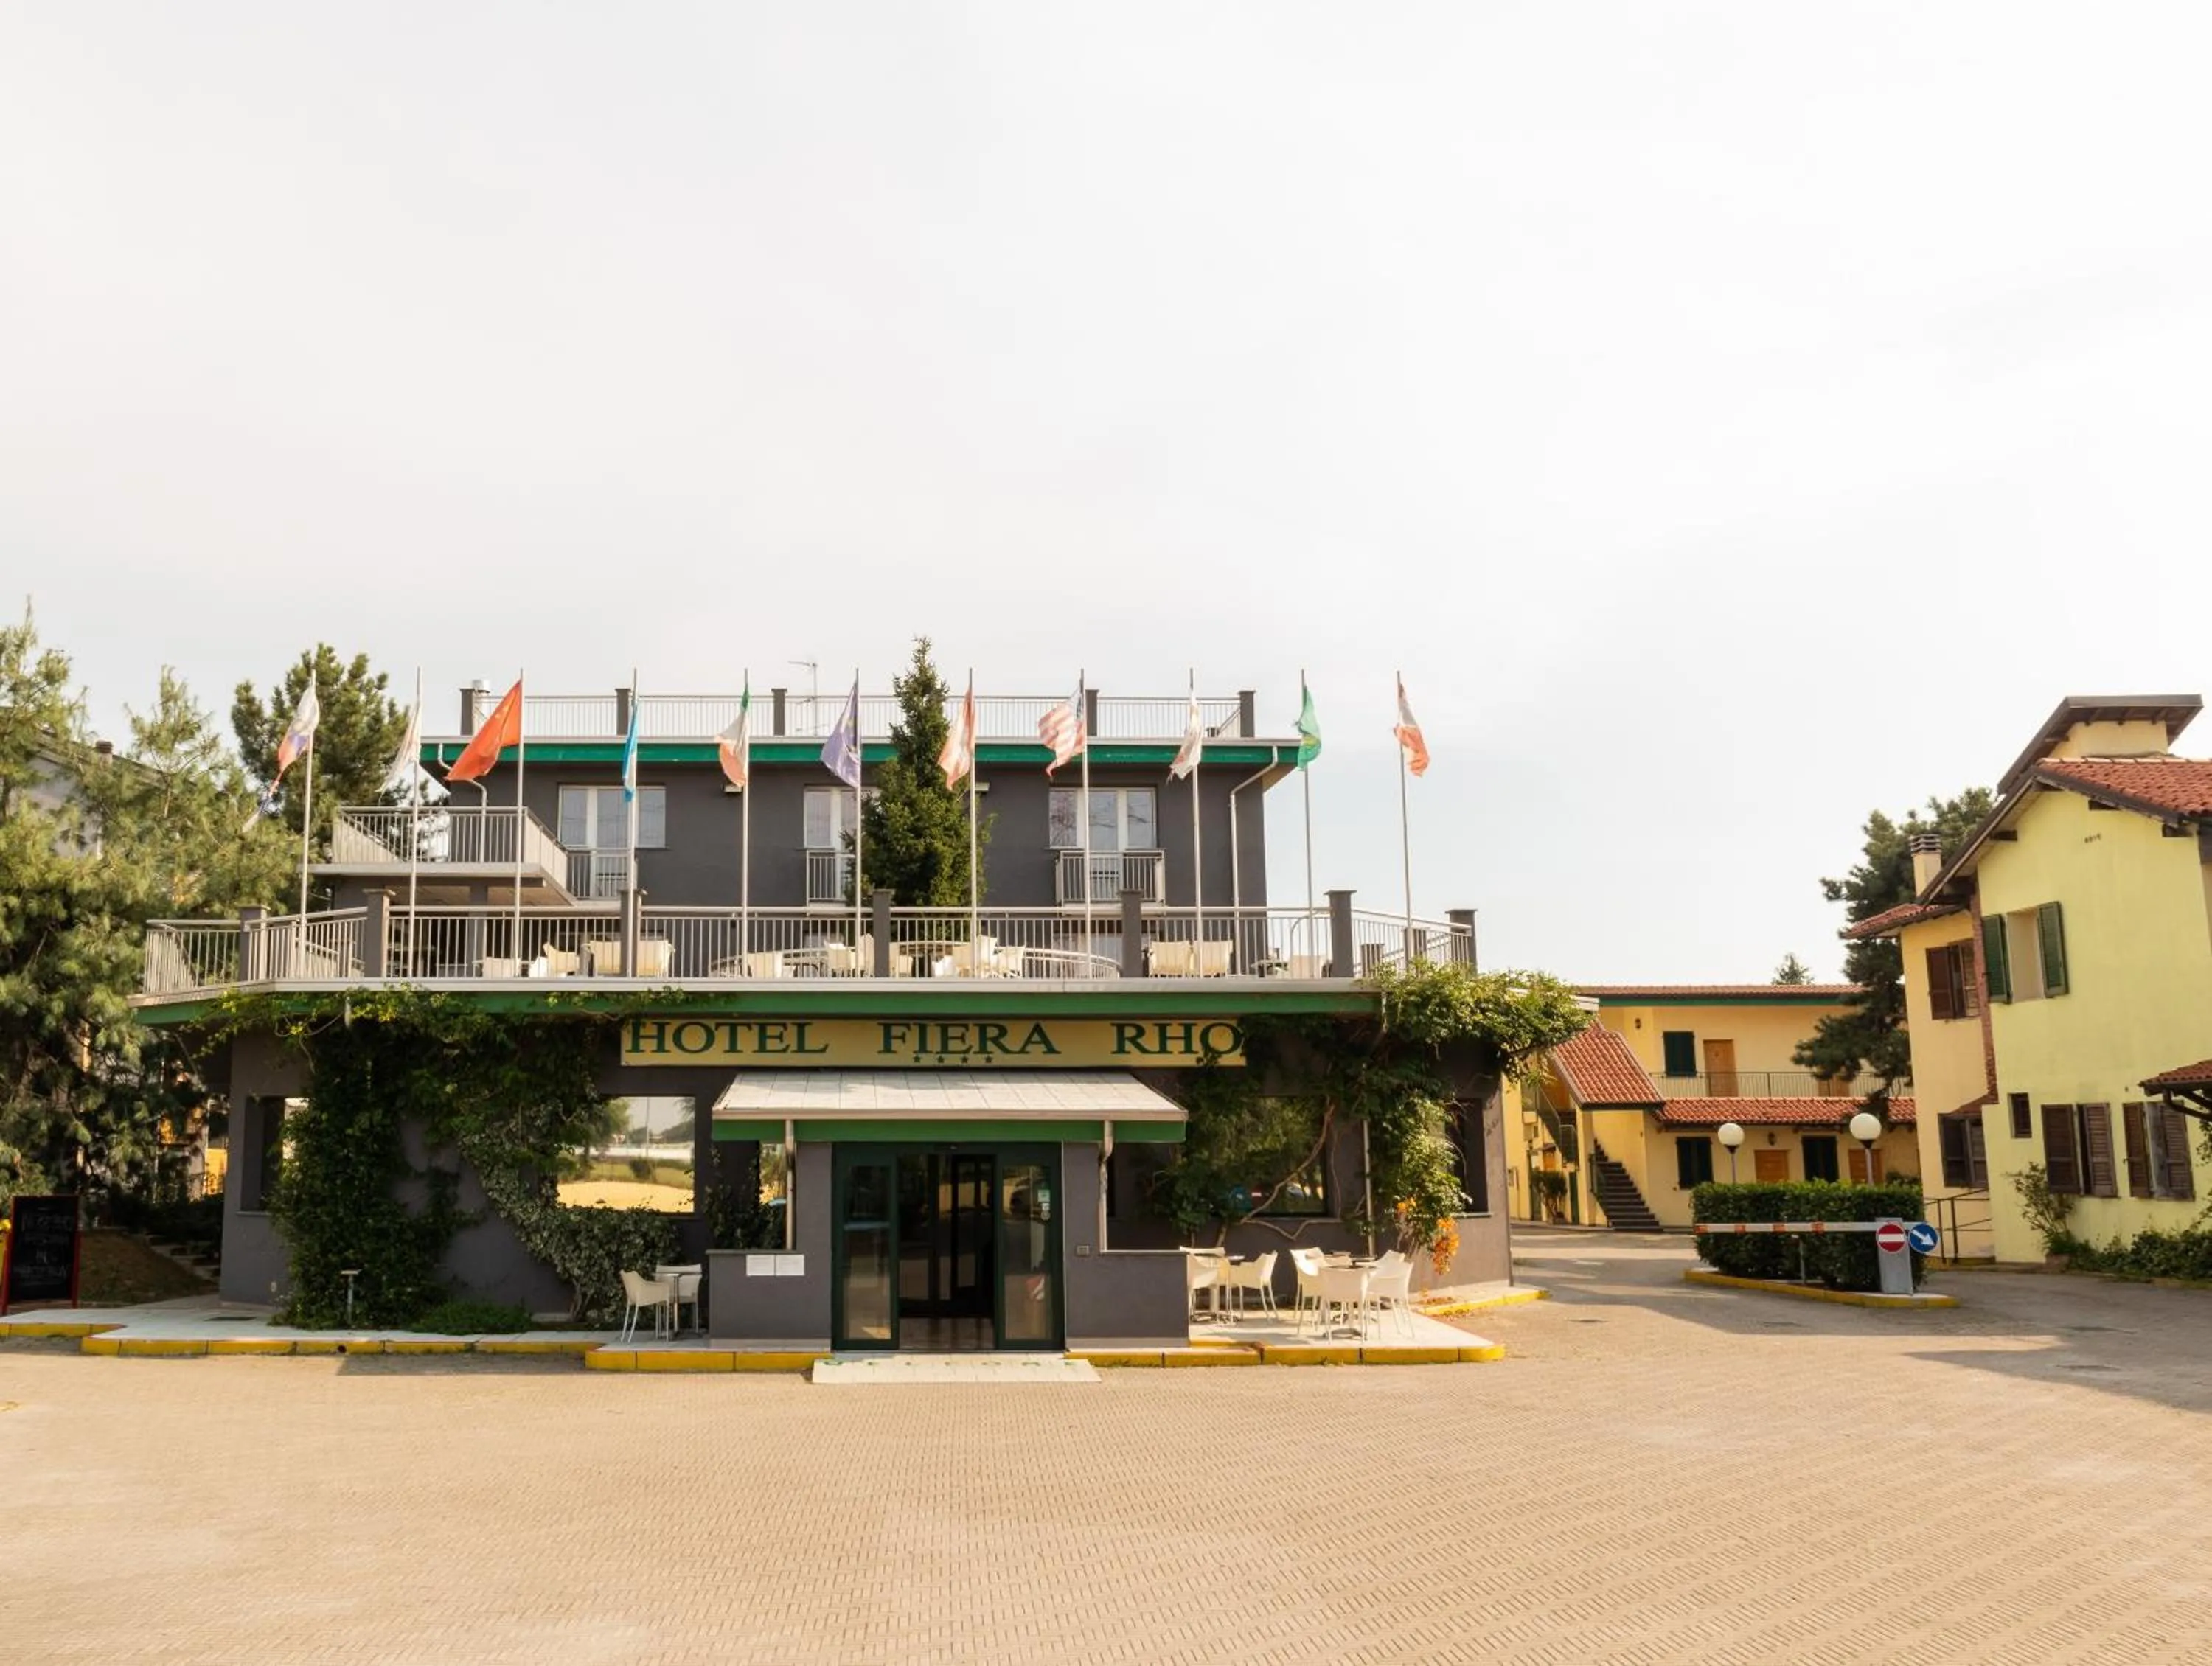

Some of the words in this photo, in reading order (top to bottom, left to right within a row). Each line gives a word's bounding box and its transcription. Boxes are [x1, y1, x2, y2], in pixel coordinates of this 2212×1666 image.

[625, 1021, 830, 1053] HOTEL
[877, 1022, 1062, 1054] FIERA
[1110, 1022, 1245, 1054] RHO
